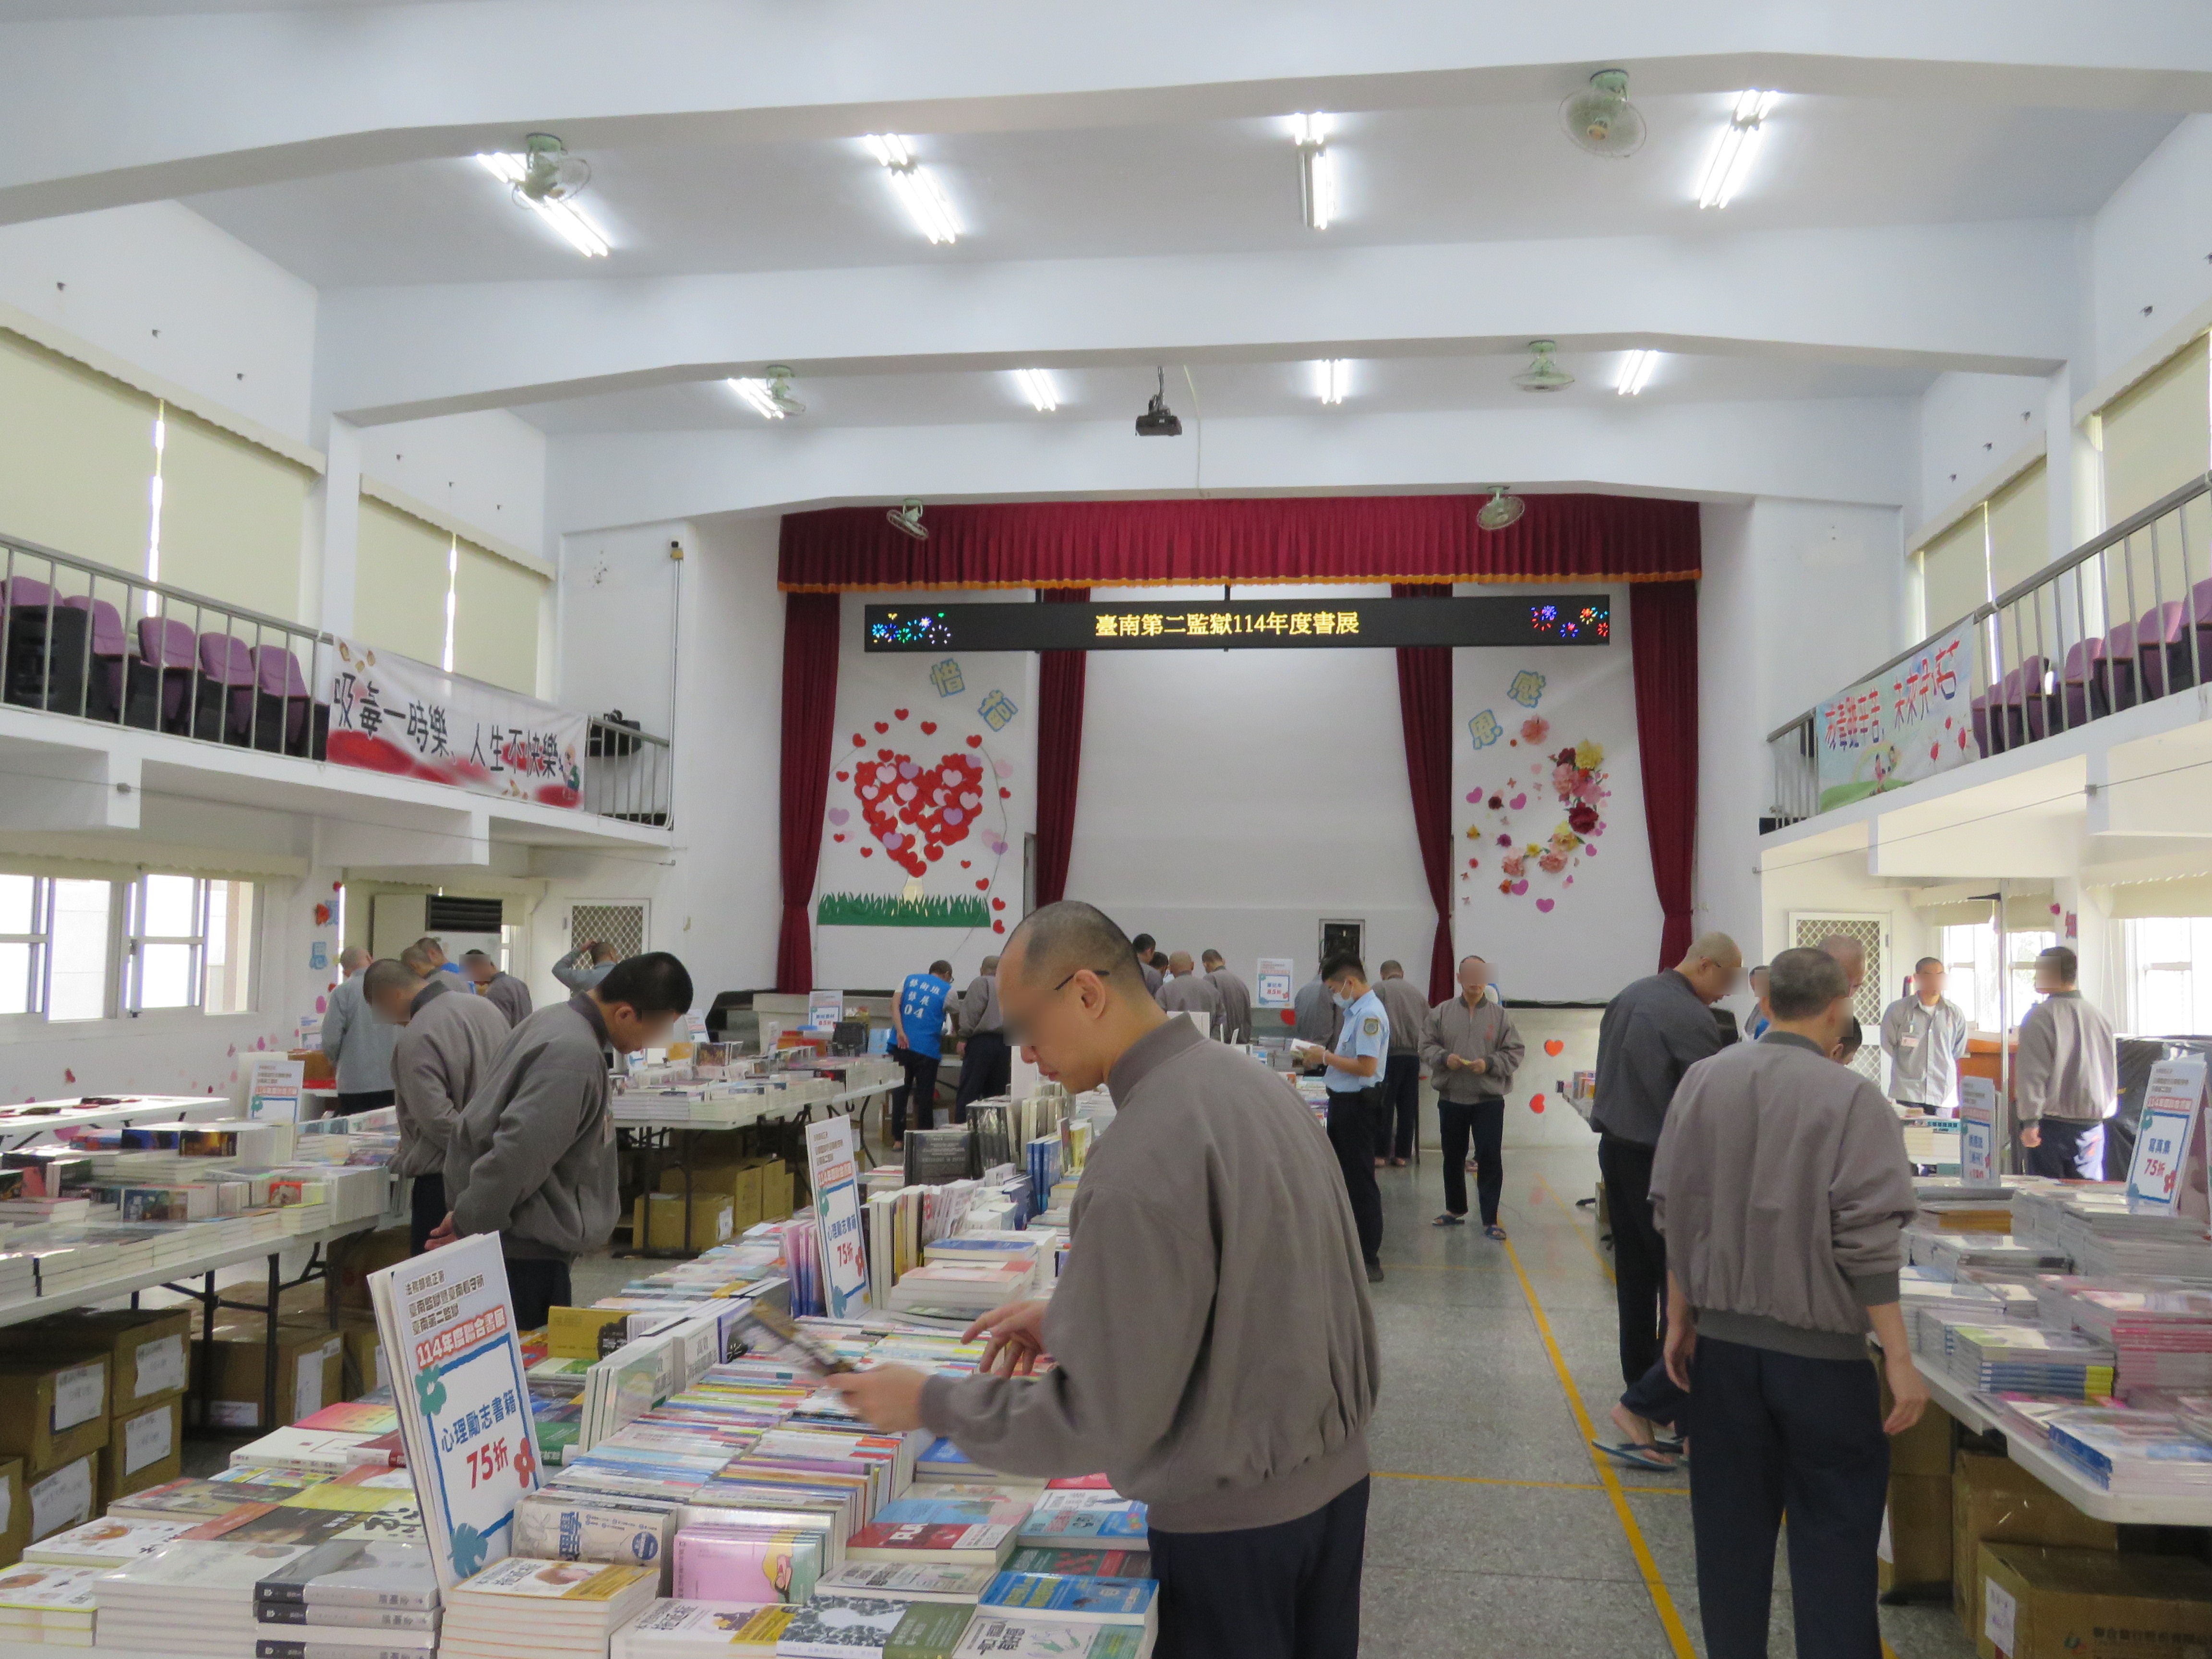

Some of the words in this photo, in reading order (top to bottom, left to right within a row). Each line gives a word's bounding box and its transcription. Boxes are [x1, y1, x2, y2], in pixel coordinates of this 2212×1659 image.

[1095, 612, 1359, 637] 臺南第二監獄114年度書展
[417, 1306, 506, 1367] 114年度聯合書展
[441, 1389, 517, 1453] 心理勵志書籍
[466, 1437, 509, 1490] 75折
